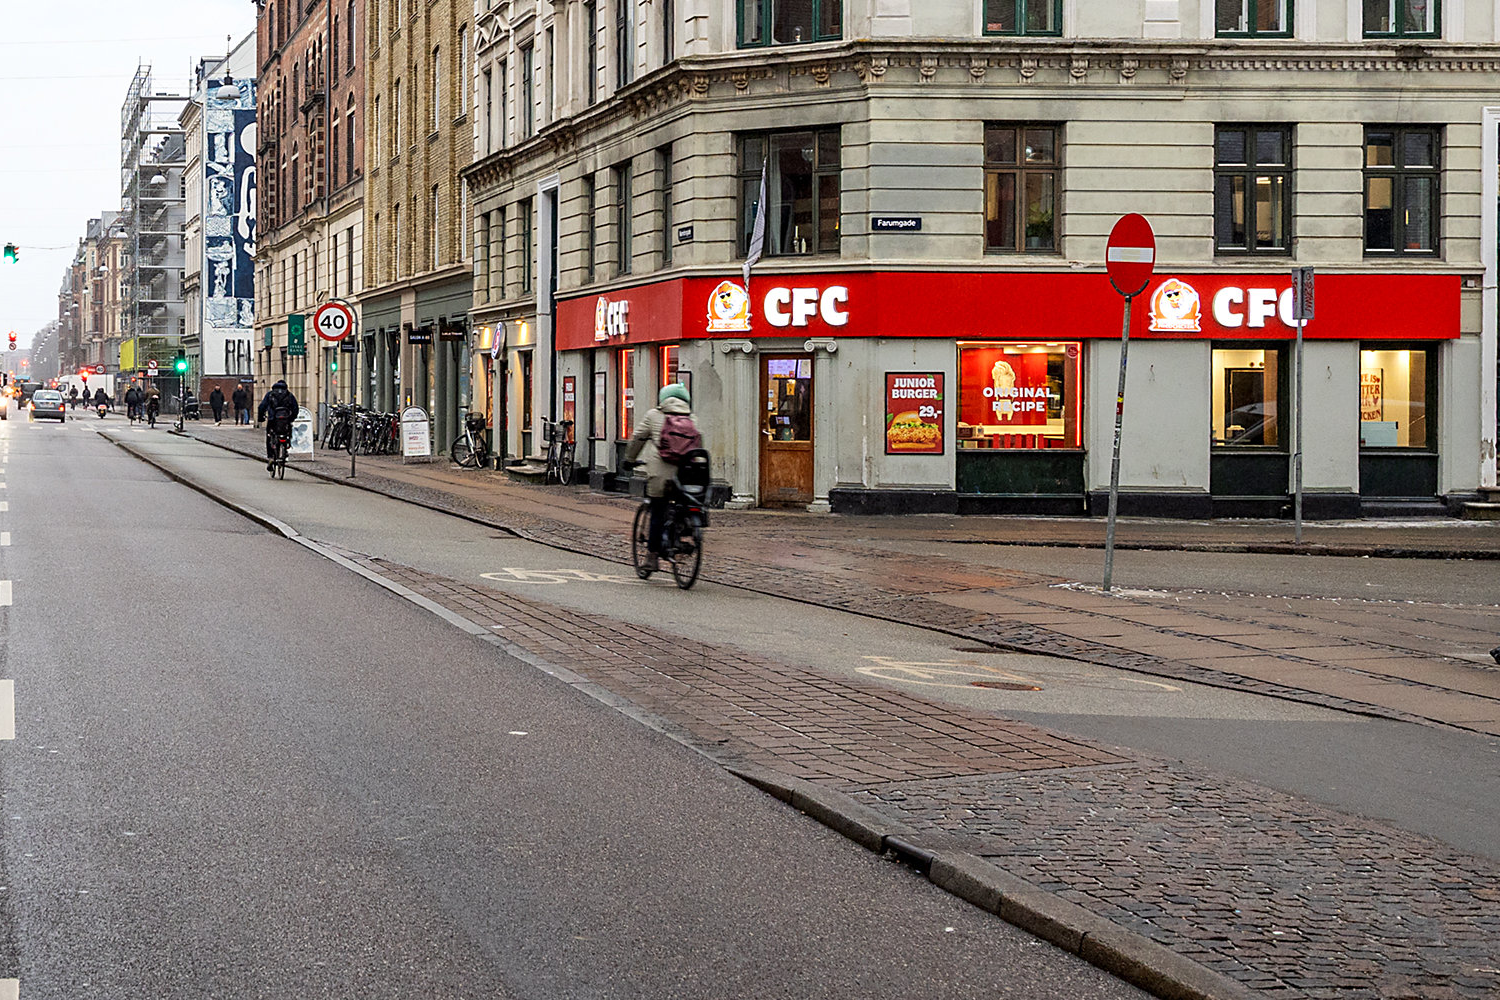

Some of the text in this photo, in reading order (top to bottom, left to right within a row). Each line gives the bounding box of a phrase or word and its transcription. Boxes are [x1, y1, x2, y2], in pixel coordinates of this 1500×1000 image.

[877, 220, 916, 228] Farumgade
[764, 286, 849, 327] CFC
[1212, 286, 1308, 328] CFC
[320, 314, 345, 330] 40
[607, 300, 629, 336] CFC
[894, 378, 935, 388] JUNIOR
[892, 389, 938, 399] BURGER
[983, 387, 1054, 398] ORIGINAL
[1361, 385, 1380, 395] TTER
[919, 405, 942, 419] 29,-
[992, 401, 1045, 412] RECIPE
[1361, 409, 1381, 420] ICKEN
